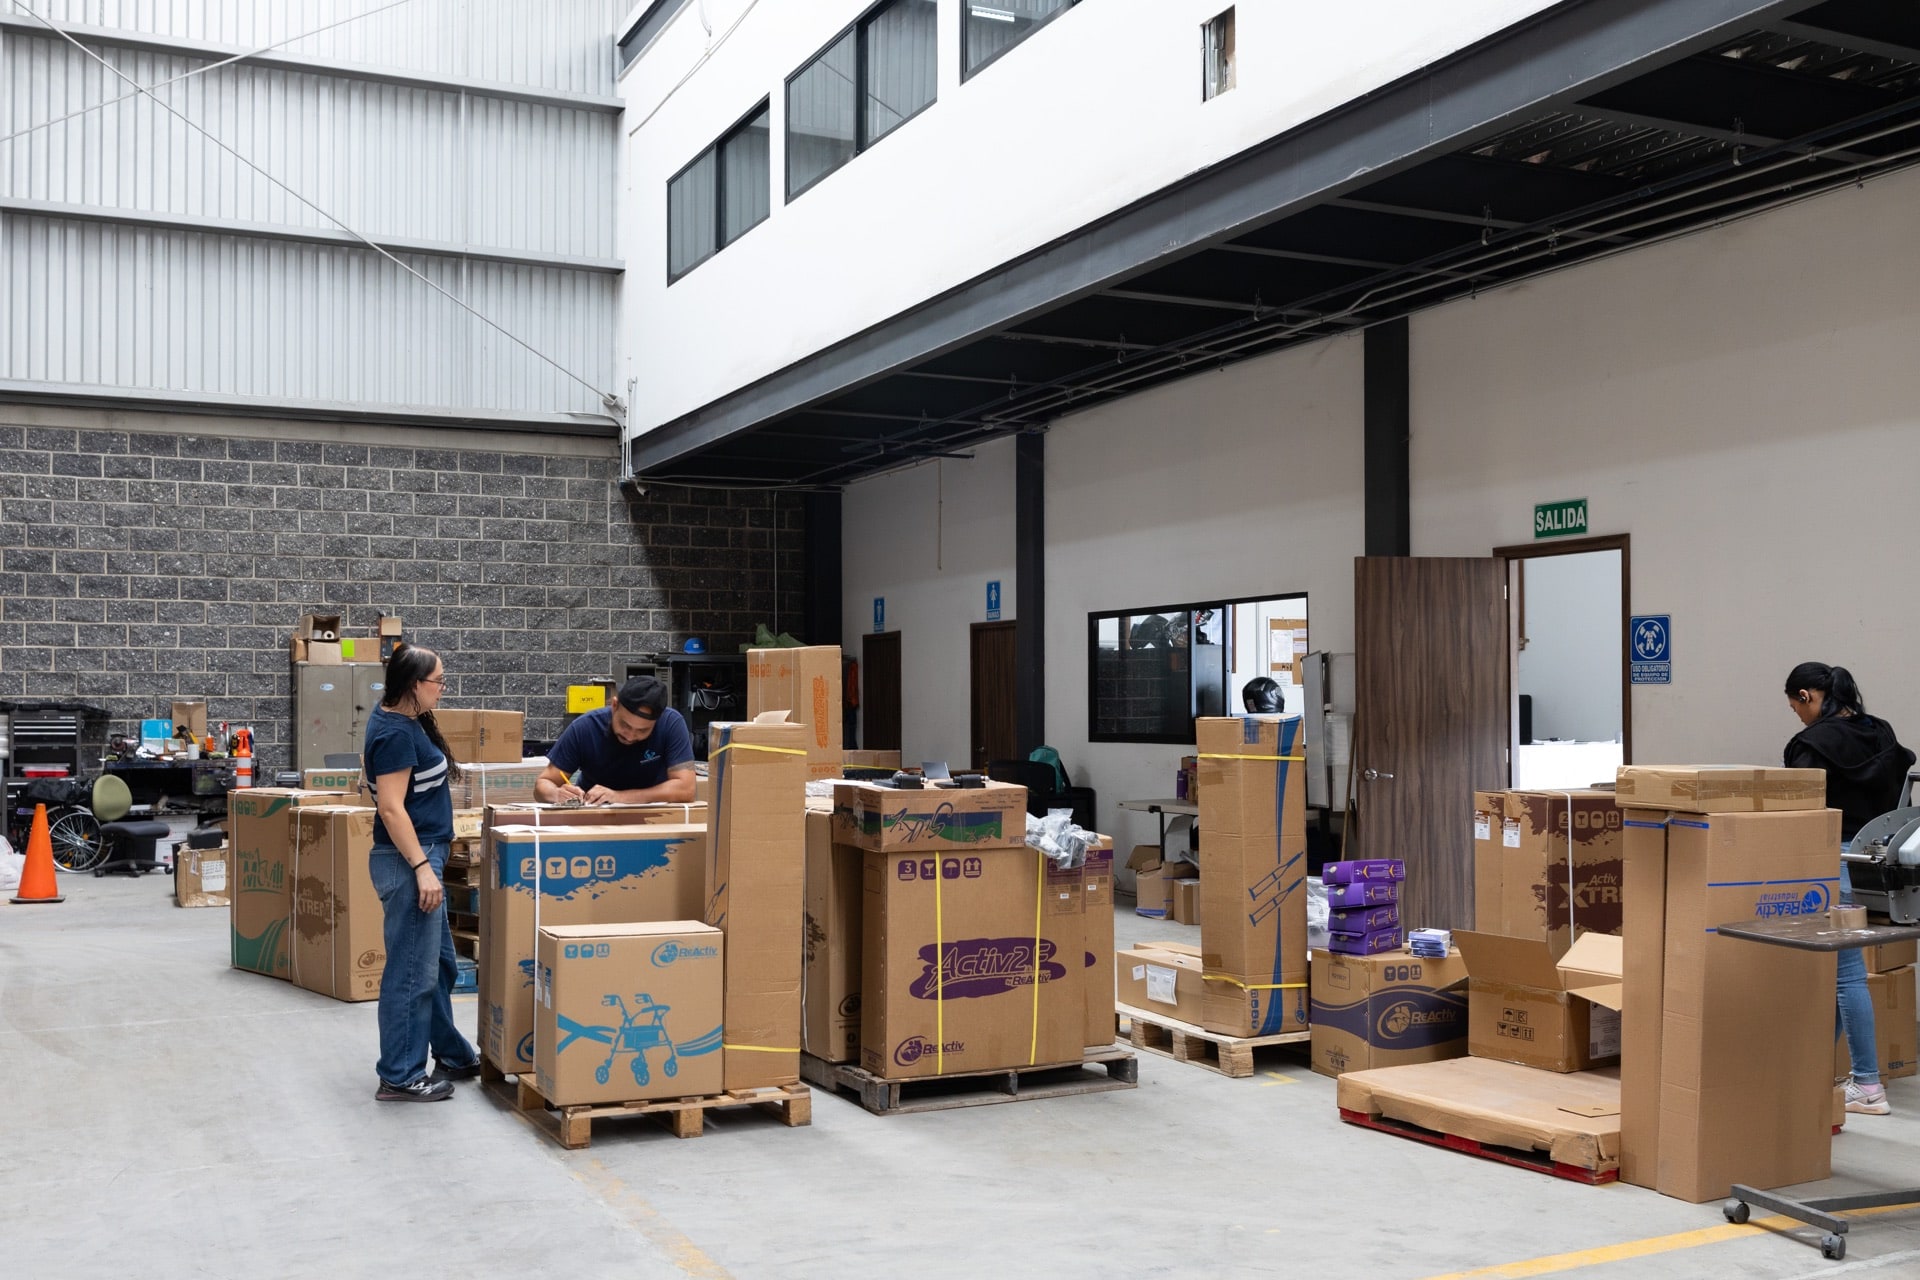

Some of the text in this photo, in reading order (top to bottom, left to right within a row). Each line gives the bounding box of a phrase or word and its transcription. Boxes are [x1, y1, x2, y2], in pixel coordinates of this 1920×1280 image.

[1536, 507, 1586, 532] SALIDA
[1589, 873, 1618, 886] Activ
[1760, 892, 1798, 902] Industrial
[1755, 901, 1801, 919] ReActiv
[680, 946, 718, 957] ReActiv
[1411, 1008, 1457, 1025] ReActiv
